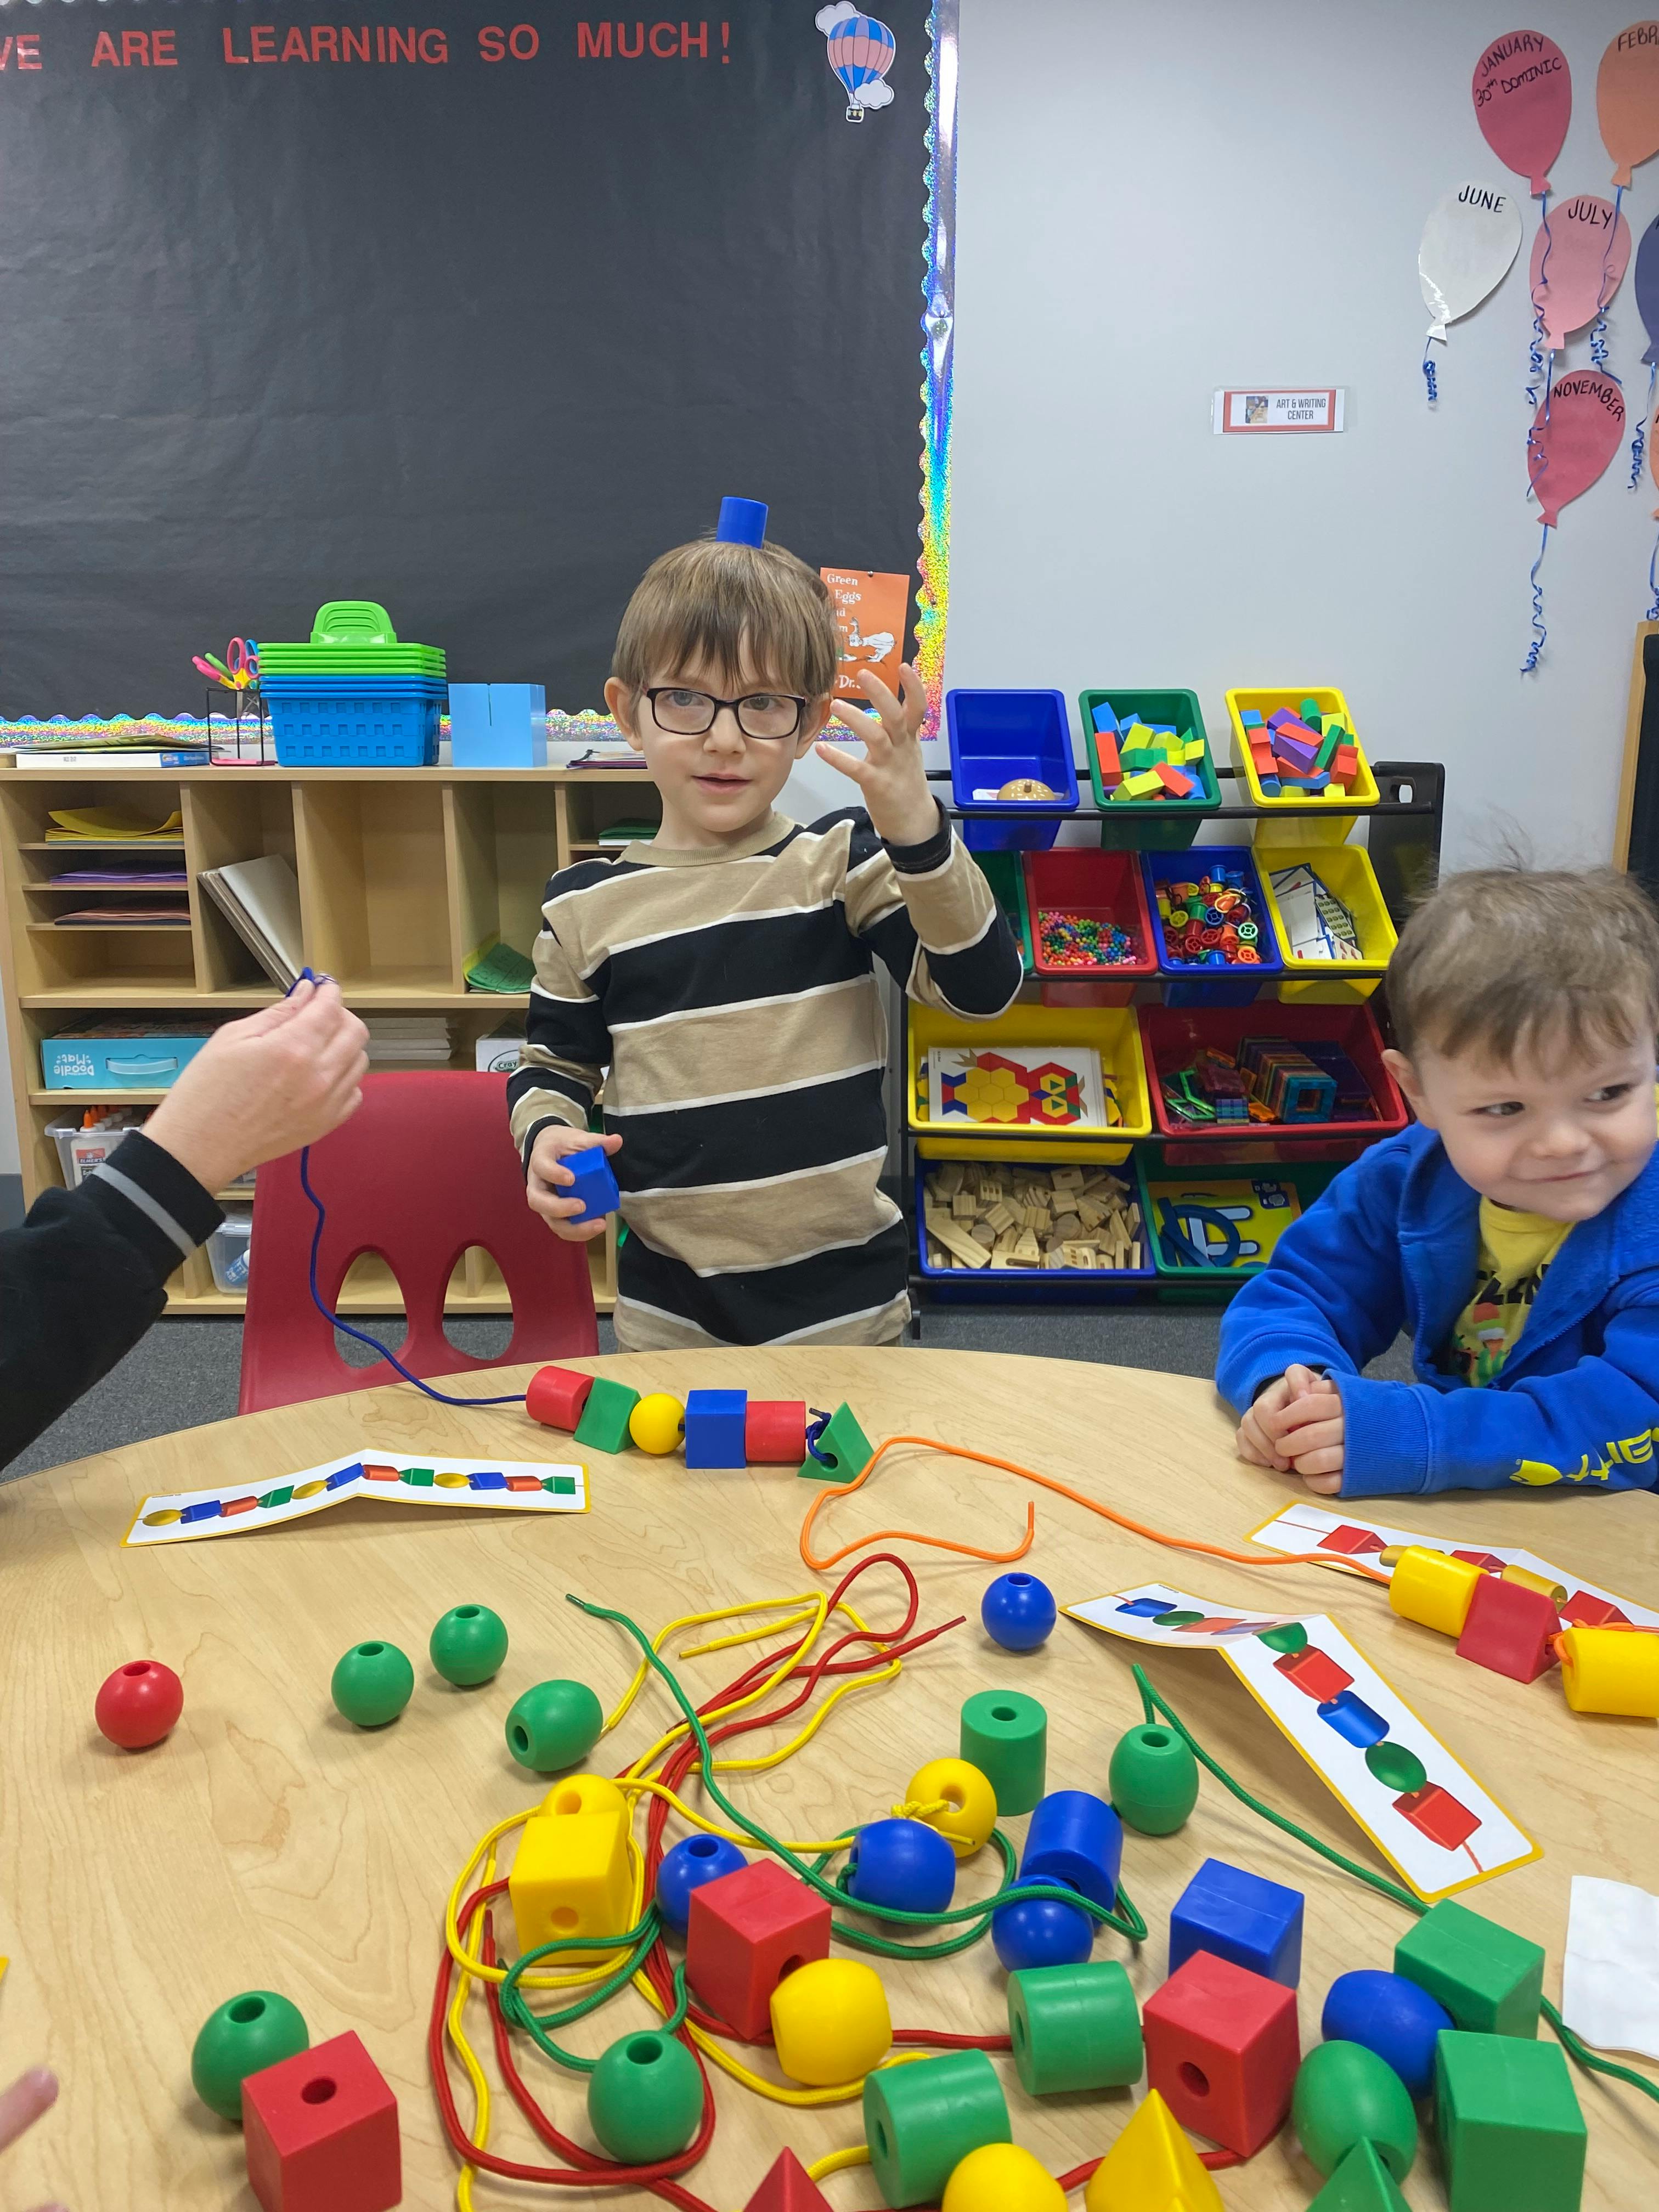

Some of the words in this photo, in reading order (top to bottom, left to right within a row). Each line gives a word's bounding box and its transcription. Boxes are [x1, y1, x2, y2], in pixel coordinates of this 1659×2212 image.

[92, 30, 178, 67] ARE
[222, 26, 448, 64] LEARNING
[480, 24, 540, 62] SO
[1482, 34, 1544, 77] JANUARY
[1476, 78, 1498, 107] 30th
[1501, 57, 1562, 94] DOMINIC
[1458, 185, 1506, 213] JUNE
[1568, 199, 1613, 229] JULY
[1276, 399, 1289, 408] ART
[1291, 399, 1296, 408] &
[1298, 398, 1326, 408] WRITING
[1554, 381, 1623, 421] NOVEMBER
[1287, 410, 1313, 420] CENTER
[826, 573, 858, 586] Green
[835, 589, 862, 605] Eggs
[53, 1065, 94, 1076] Doodle
[61, 1054, 85, 1065] Mat
